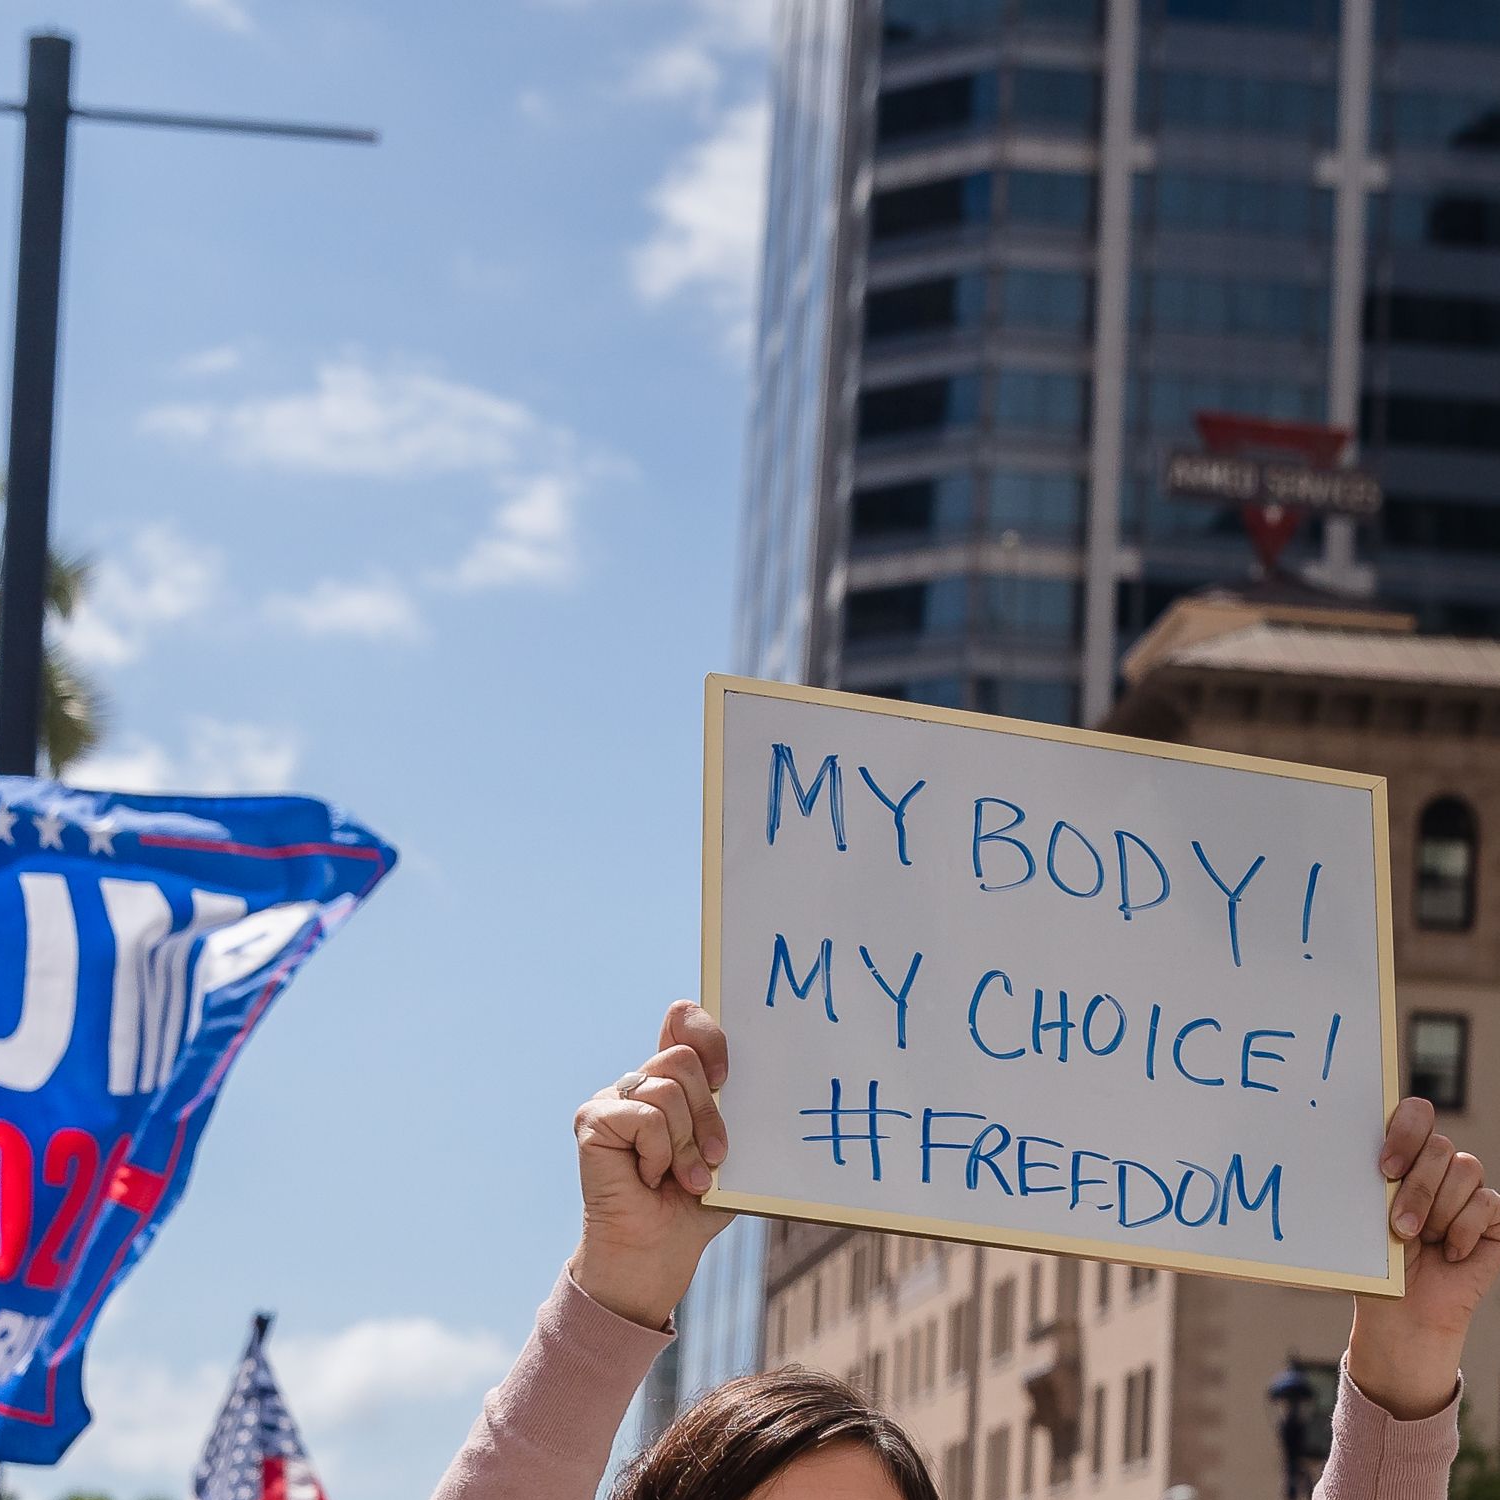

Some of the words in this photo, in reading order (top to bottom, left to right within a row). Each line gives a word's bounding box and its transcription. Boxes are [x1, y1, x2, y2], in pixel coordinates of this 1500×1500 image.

[767, 742, 926, 866] MY
[972, 797, 1323, 968] BODY!
[766, 933, 923, 1050] MY
[968, 969, 1341, 1108] CHOICE!
[798, 1077, 1284, 1242] #FREEDOM
